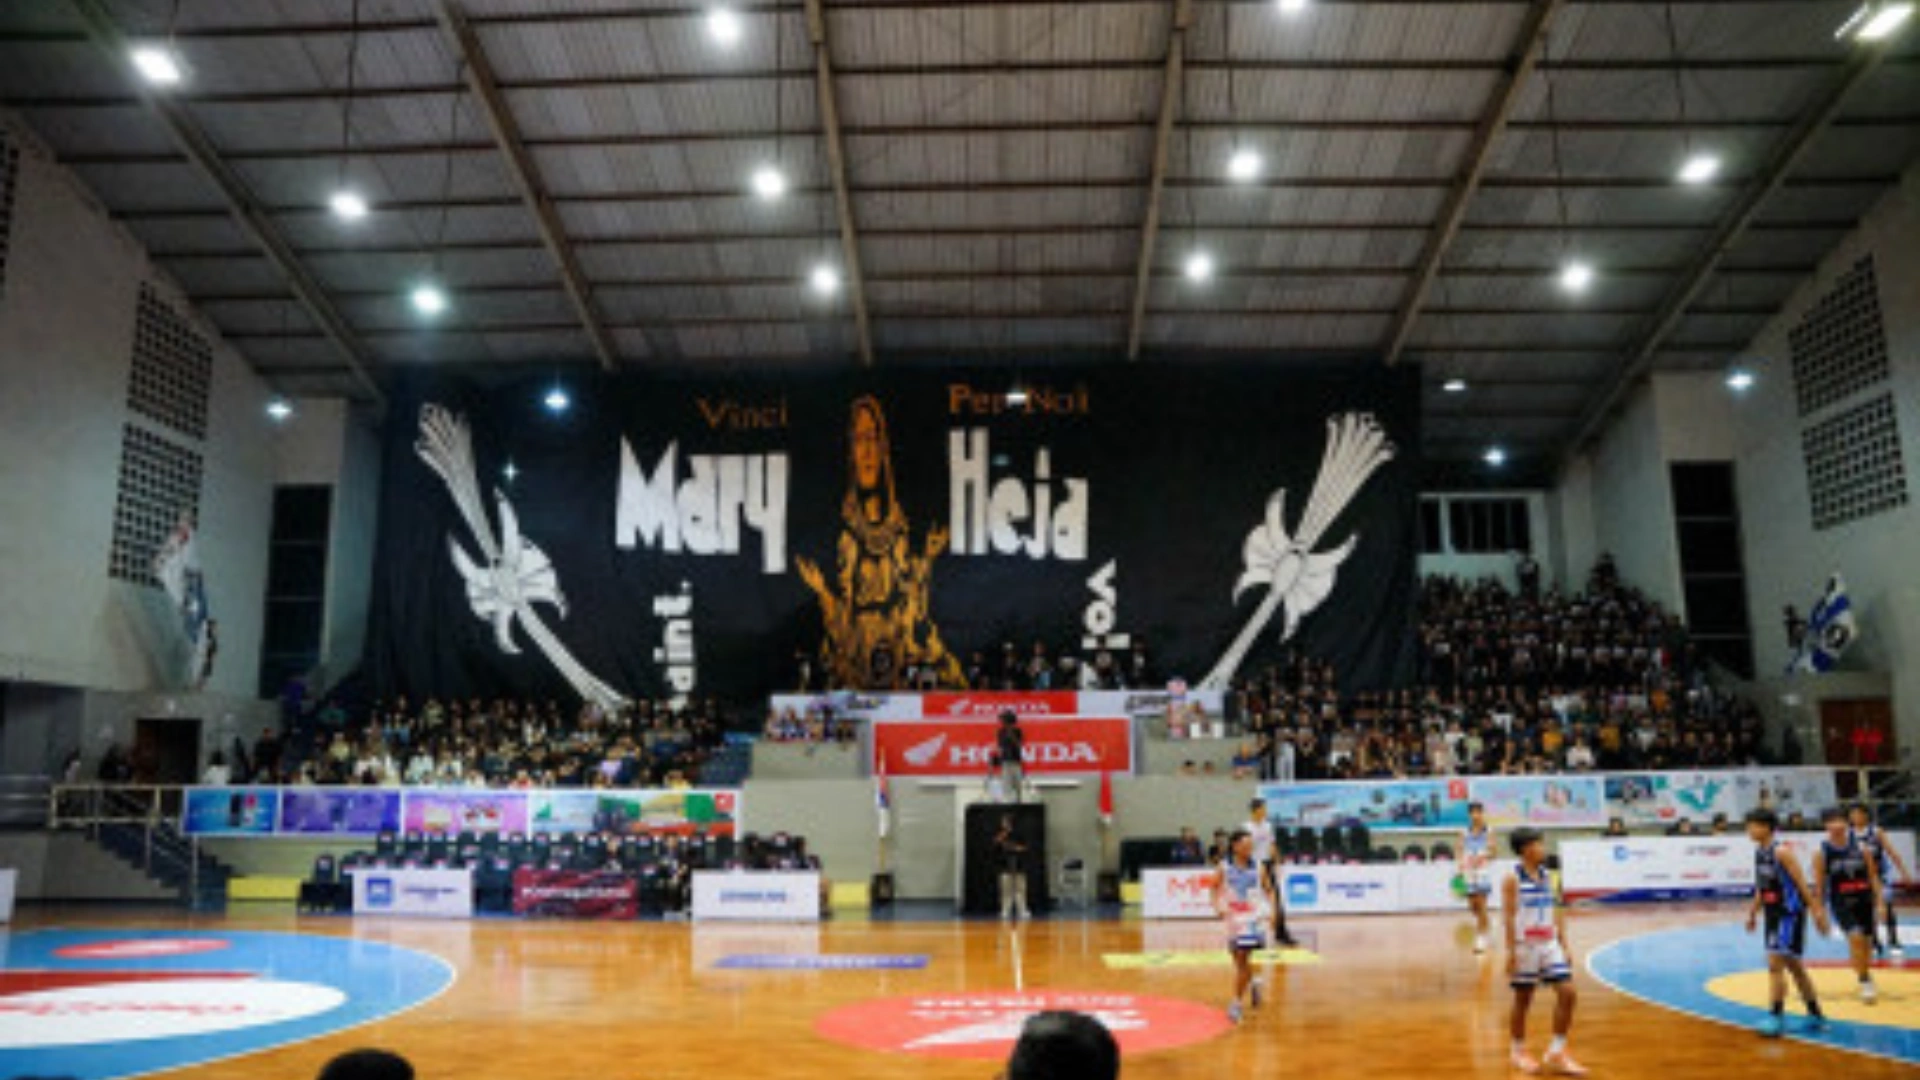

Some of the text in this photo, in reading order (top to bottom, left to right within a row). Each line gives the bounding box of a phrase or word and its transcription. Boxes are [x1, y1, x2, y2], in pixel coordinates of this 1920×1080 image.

[696, 398, 788, 428] Vinci
[615, 434, 788, 574] Mary
[949, 427, 1089, 560] Heja
